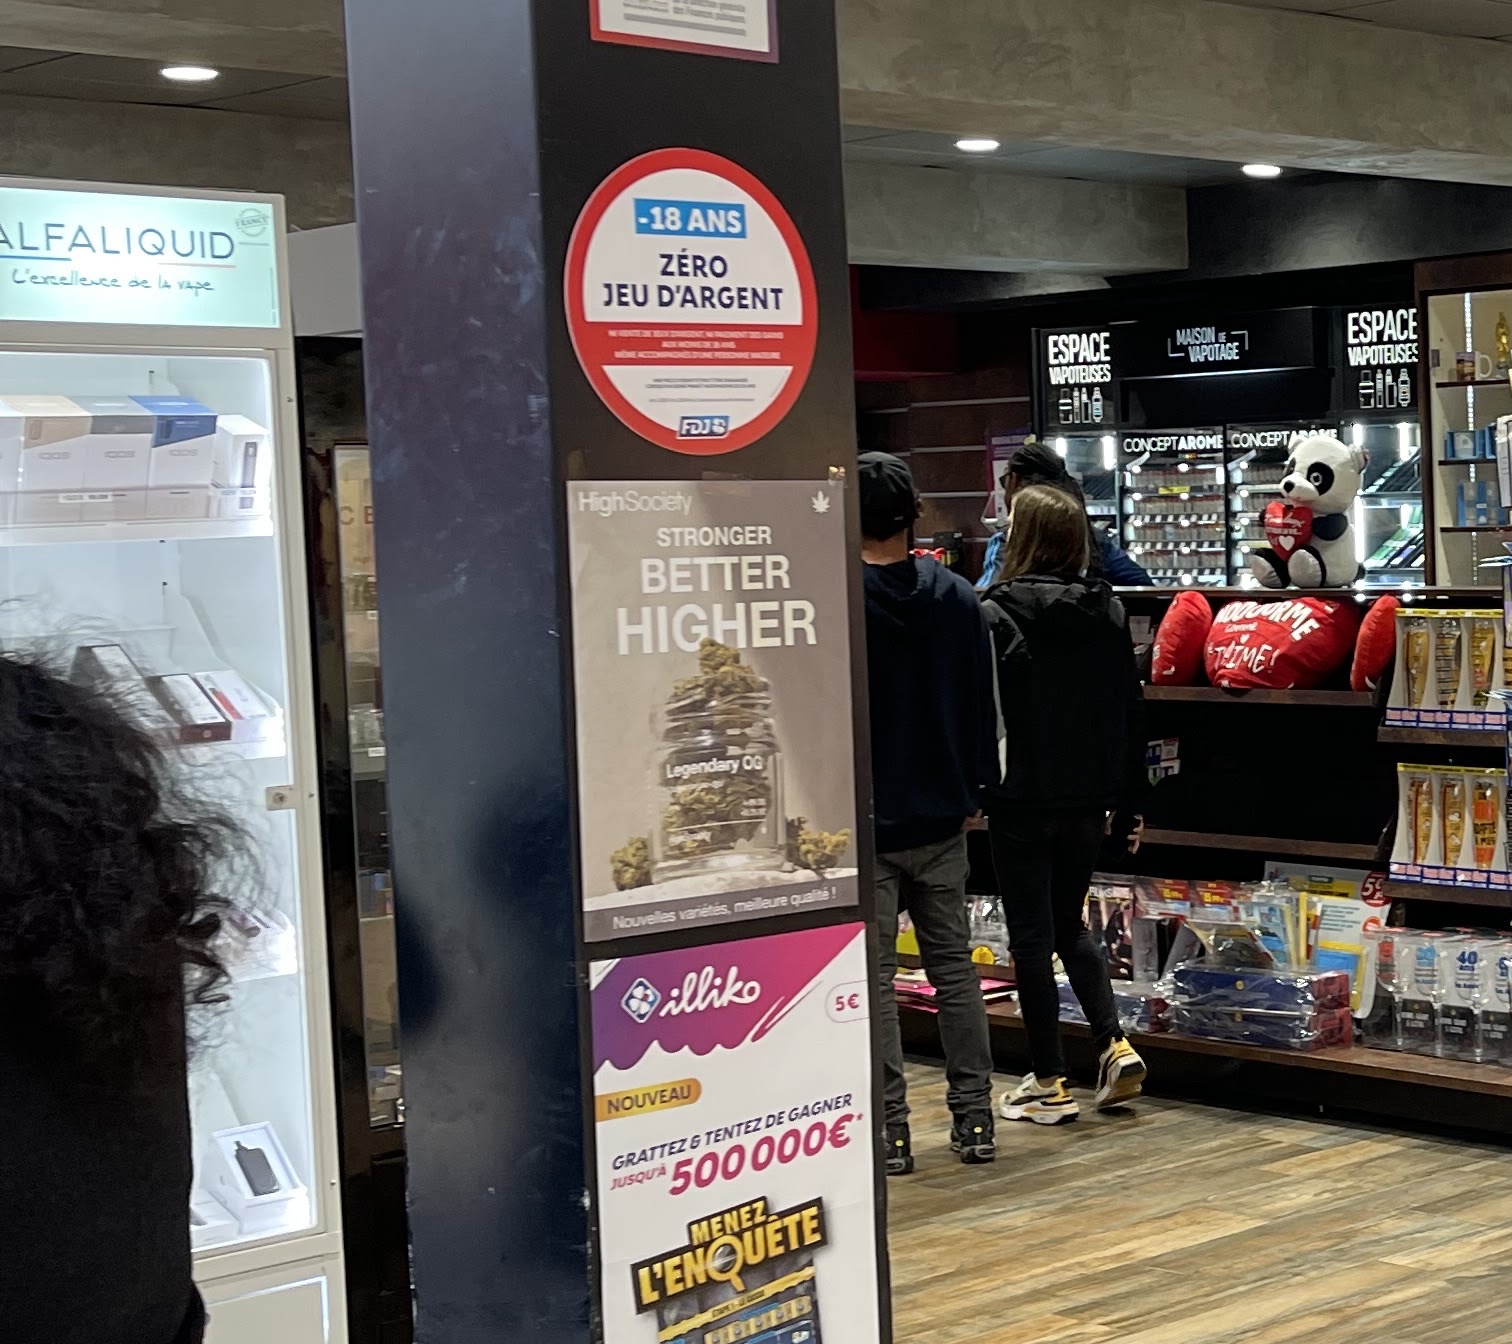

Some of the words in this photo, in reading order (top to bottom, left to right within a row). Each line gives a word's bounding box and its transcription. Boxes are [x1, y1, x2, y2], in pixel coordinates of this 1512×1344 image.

[638, 207, 682, 231] -18
[687, 208, 742, 234] ANS
[659, 248, 728, 278] ZÉRO
[603, 283, 649, 307] JEU
[657, 284, 784, 310] D'ARGENT
[1176, 326, 1216, 346] MAISON
[1217, 331, 1227, 342] DE
[1347, 308, 1418, 344] ESPACE
[1048, 332, 1111, 365] ESPACE
[1188, 342, 1240, 363] VAPOTAGE
[1347, 342, 1420, 368] VAPOTEUSES
[1049, 363, 1111, 385] VAPOTEUSES
[681, 419, 711, 434] FDJ
[1123, 434, 1224, 452] CONCEPTAROME
[656, 525, 772, 547] STRONGER
[640, 555, 791, 594] BETTER
[617, 600, 817, 655] HIGHER
[666, 757, 739, 780] Legendary
[612, 910, 676, 930] Nouvelles
[679, 902, 732, 922] variétés,
[733, 895, 788, 914] meilleure
[790, 887, 829, 907] qualité
[659, 965, 761, 1018] illiko
[835, 993, 860, 1012] 5€
[607, 1085, 692, 1115] NOUVEAU
[612, 1138, 688, 1171] GRATTEZ
[690, 1135, 702, 1149] &
[704, 1116, 762, 1147] TENTEZ
[765, 1110, 785, 1130] DE
[788, 1093, 852, 1123] GAGNER
[610, 1165, 667, 1191] JUSQU'À
[690, 1199, 768, 1247] MENEZ
[638, 1205, 822, 1305] L'ENQUÊTE
